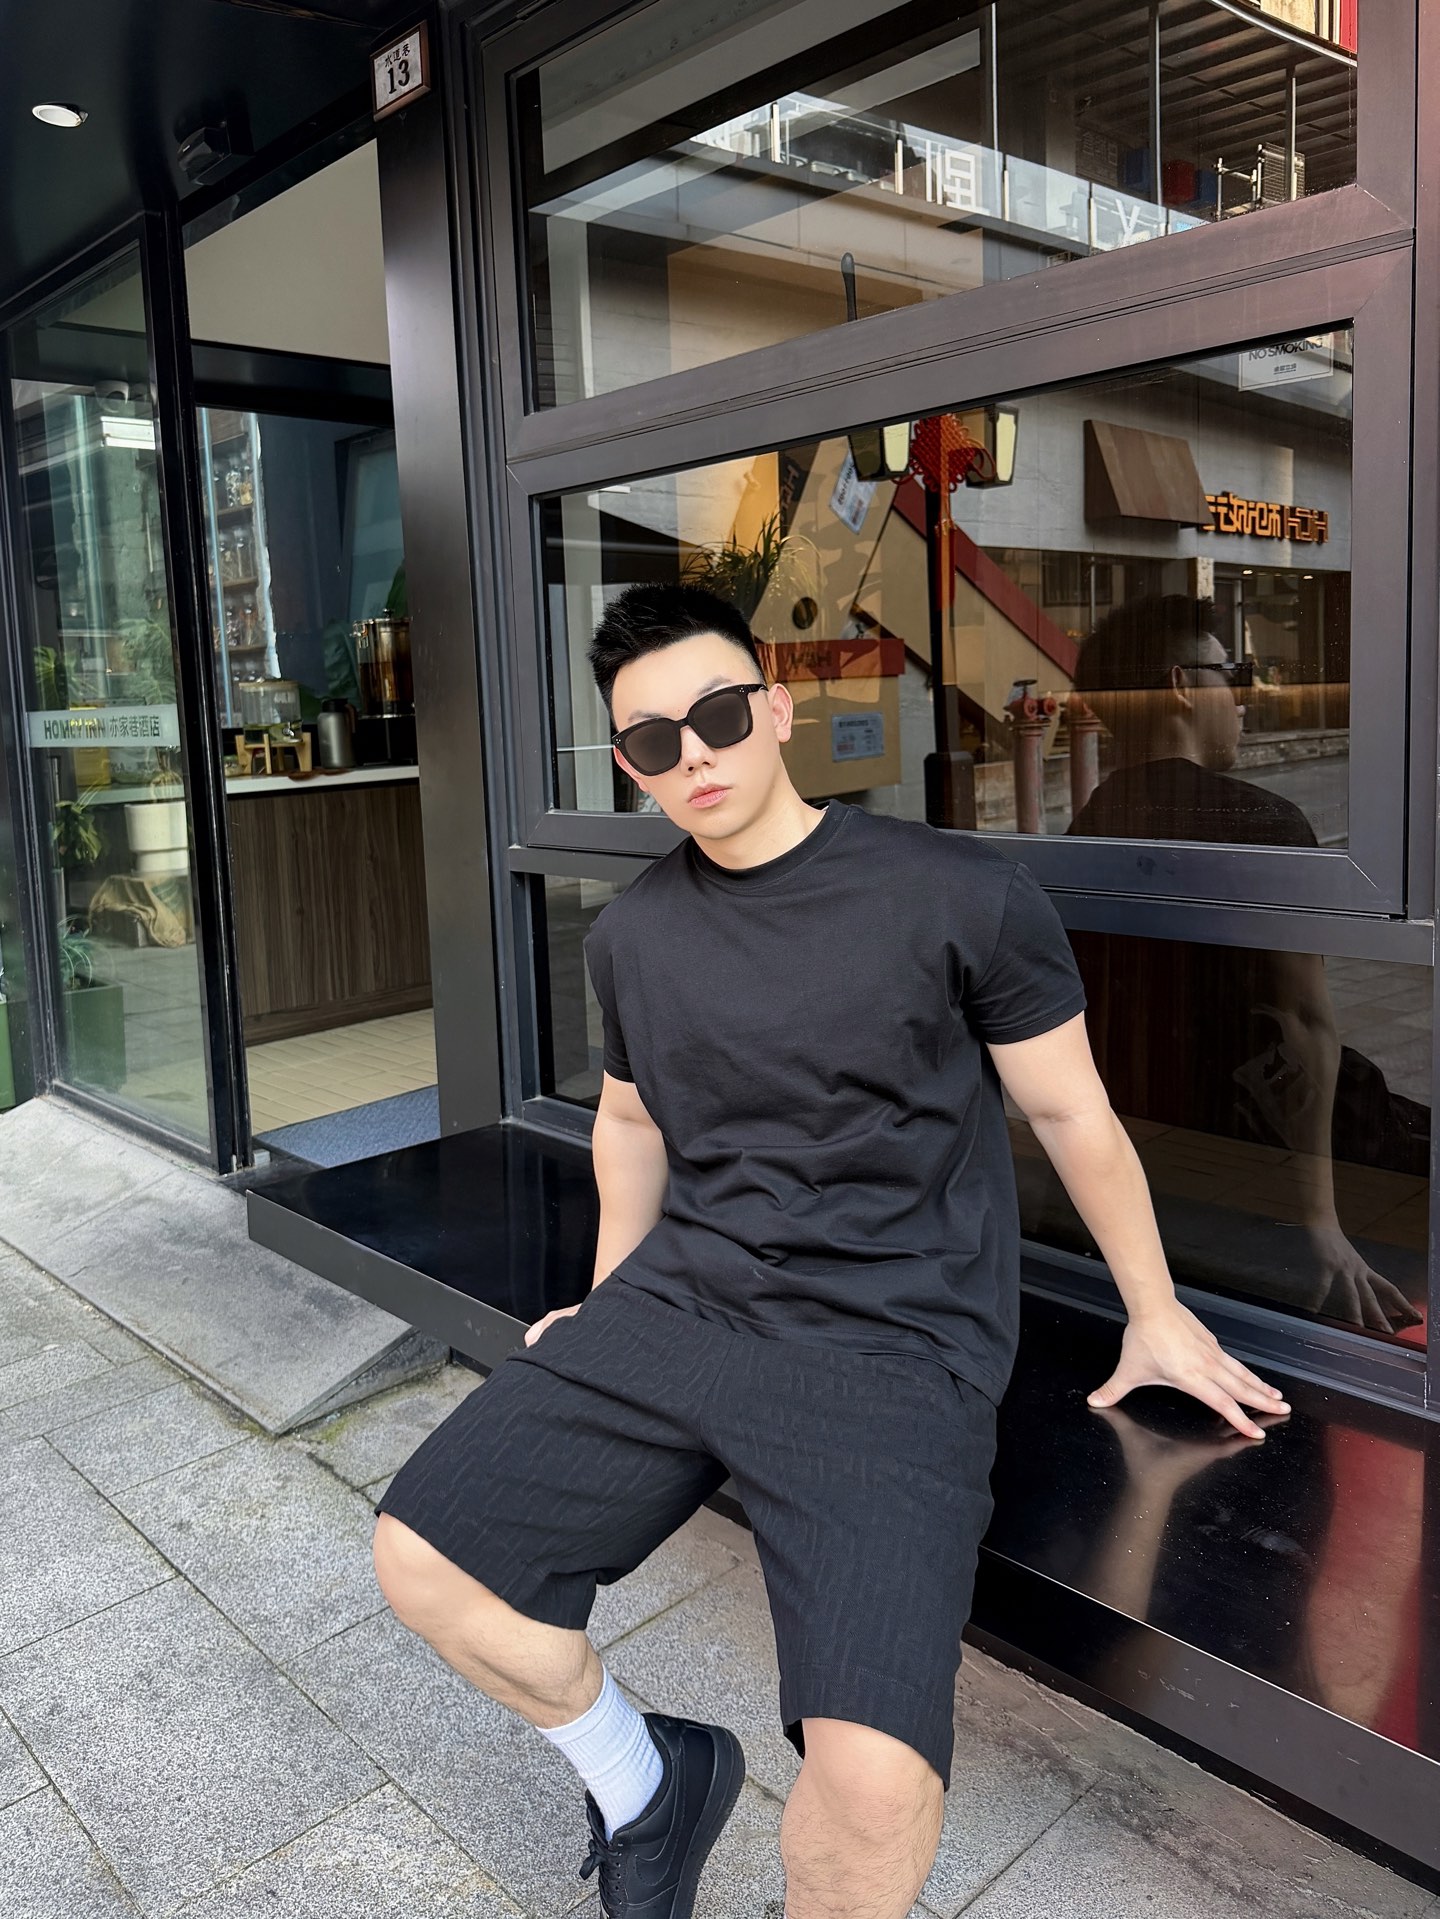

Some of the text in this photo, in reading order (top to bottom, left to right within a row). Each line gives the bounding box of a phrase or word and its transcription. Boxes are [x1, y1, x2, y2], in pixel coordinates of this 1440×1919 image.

[388, 60, 410, 94] 13
[1248, 338, 1323, 361] NO SMOKING
